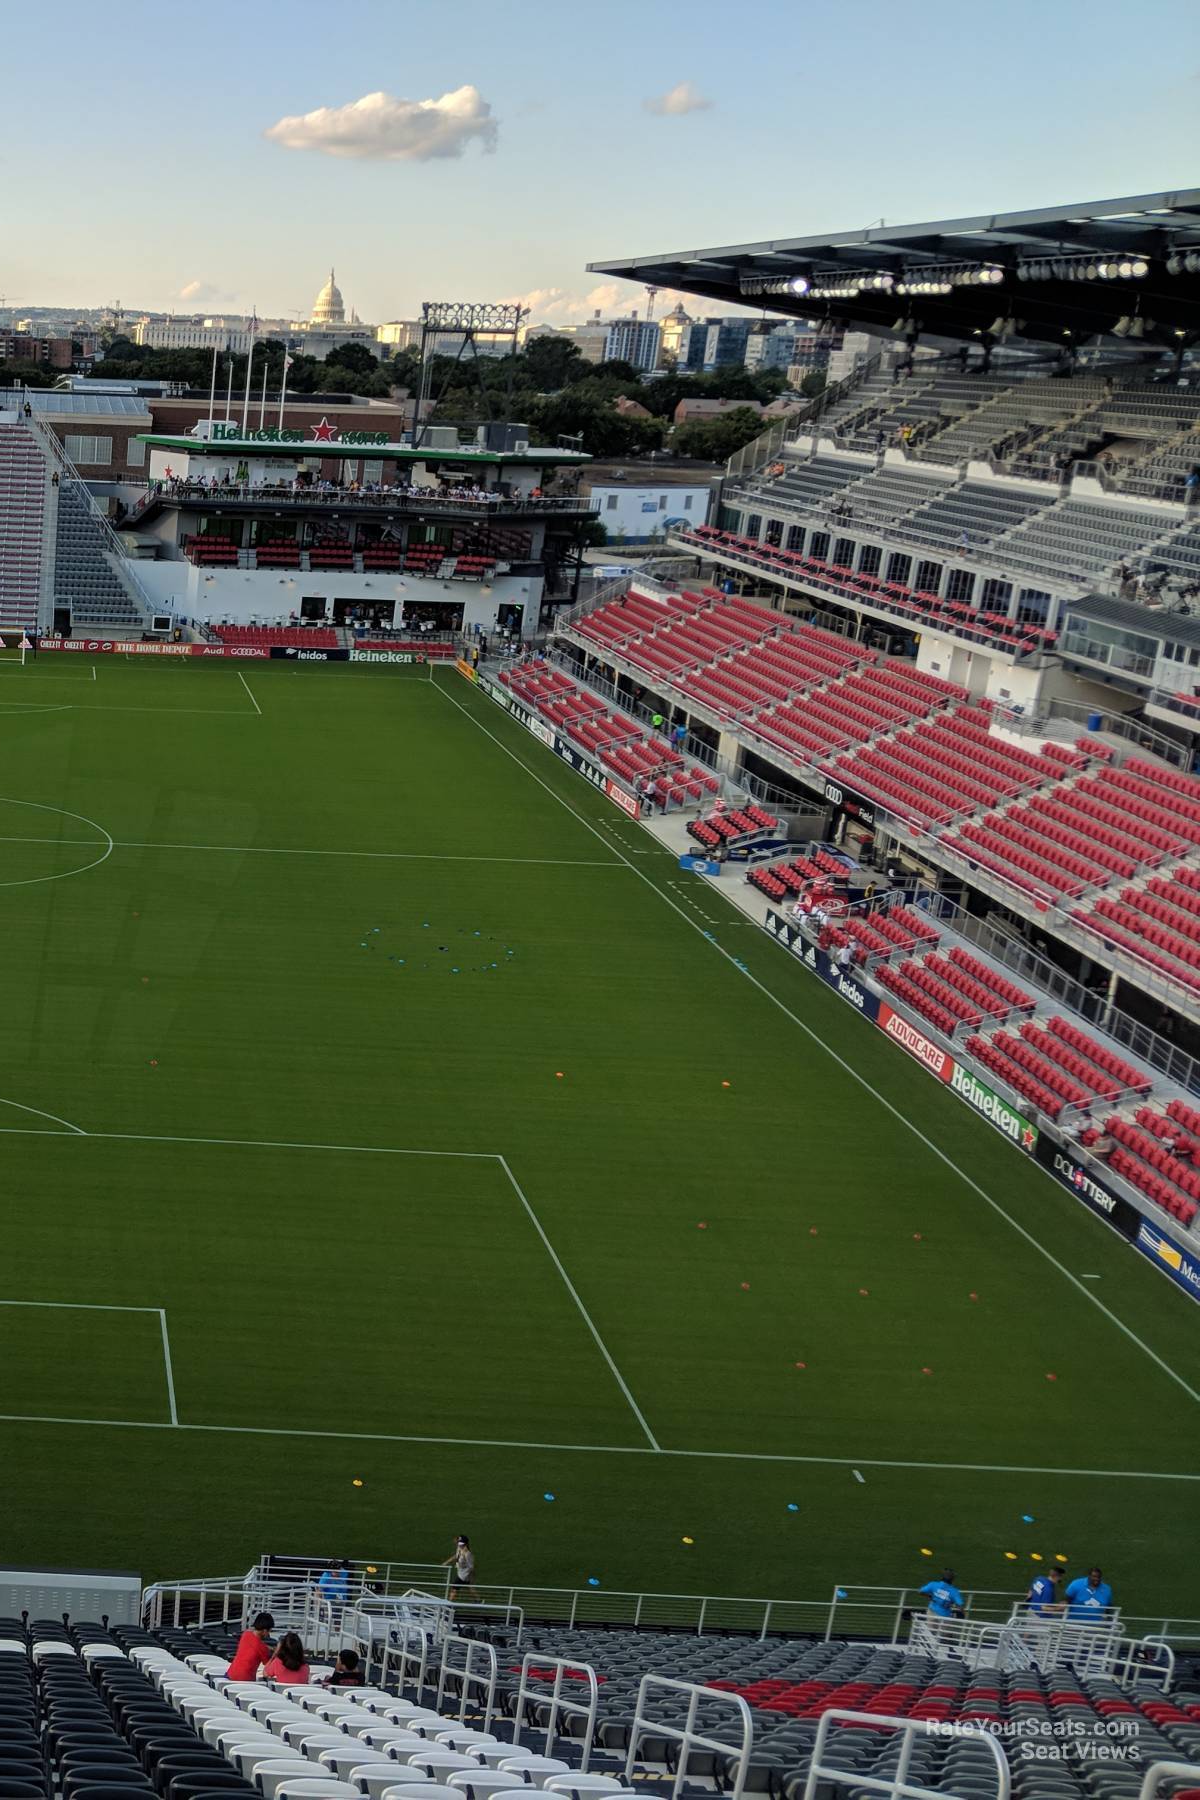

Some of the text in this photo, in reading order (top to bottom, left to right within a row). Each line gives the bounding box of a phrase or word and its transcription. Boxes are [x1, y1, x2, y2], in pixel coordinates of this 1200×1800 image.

[212, 424, 304, 443] Heineken
[117, 643, 134, 652] THE
[136, 644, 162, 653] HOME
[162, 645, 191, 654] DEPOT
[203, 647, 225, 655] Audi
[297, 650, 328, 660] leidos
[349, 650, 412, 663] Heineken
[858, 807, 874, 824] Field
[838, 975, 865, 1008] leidos
[886, 1014, 943, 1070] ADVOCARE
[951, 1062, 1020, 1140] Heineken
